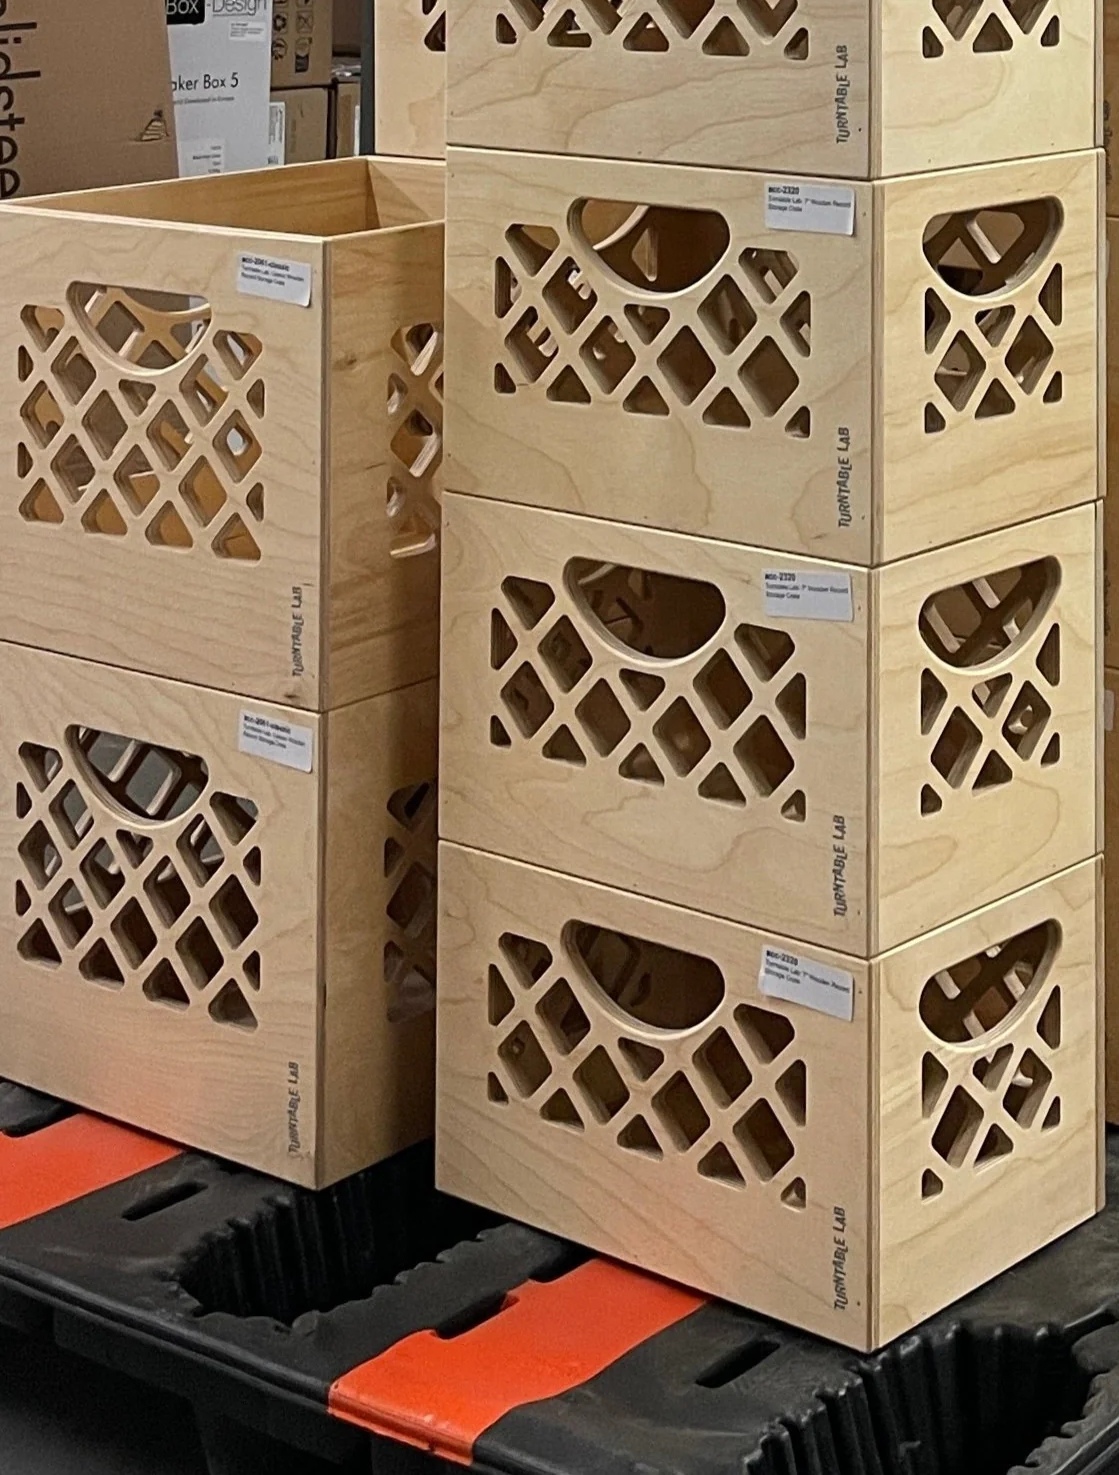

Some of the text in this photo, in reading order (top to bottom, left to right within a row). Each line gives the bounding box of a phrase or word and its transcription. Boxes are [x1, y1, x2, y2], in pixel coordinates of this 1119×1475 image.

[203, 74, 226, 89] Box
[230, 72, 239, 88] 5
[835, 45, 850, 144] TURNTABLE LAB
[836, 427, 852, 527] TURNTABLE LAB
[832, 815, 848, 917] TURNTABLE LAB
[832, 1206, 848, 1310] TURNTABLE LAB
